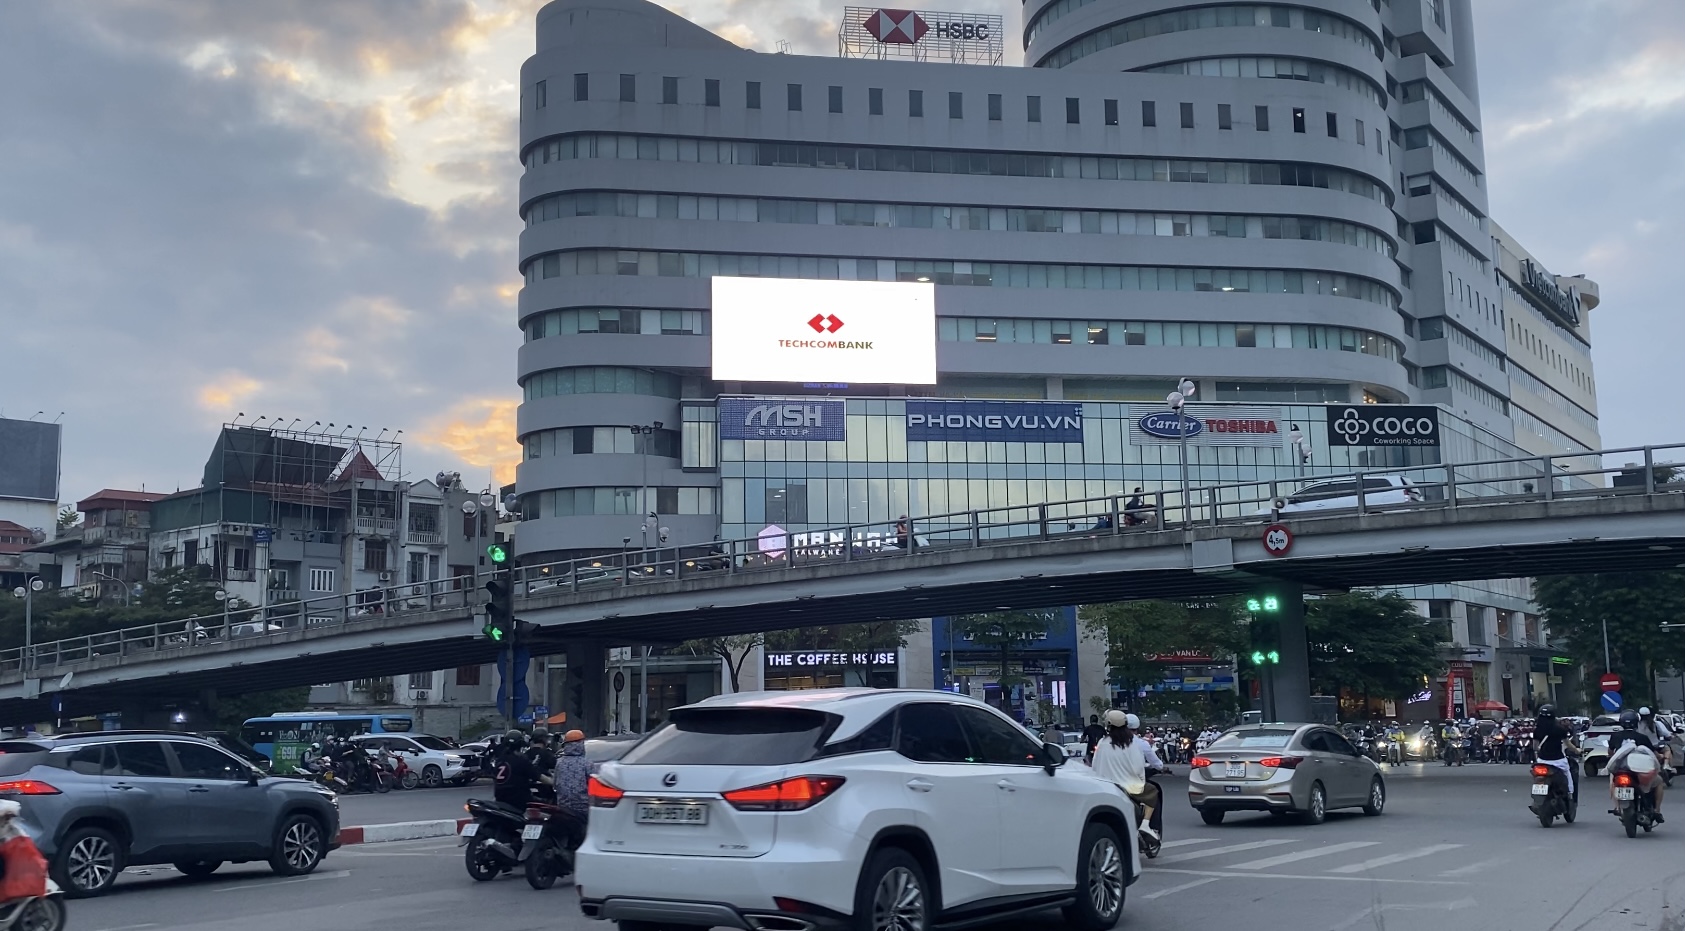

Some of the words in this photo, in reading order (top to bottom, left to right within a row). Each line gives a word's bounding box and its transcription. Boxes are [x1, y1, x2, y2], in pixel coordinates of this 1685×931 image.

[936, 22, 989, 40] HSBC
[778, 340, 873, 349] TECHCOMBANK
[744, 404, 822, 427] MSH
[908, 414, 1081, 429] PHONGVU.VN
[758, 428, 809, 436] GROUP
[1205, 419, 1278, 433] TOSHIBA
[1372, 417, 1433, 435] COGO
[1373, 437, 1412, 445] Coworking
[1413, 437, 1435, 445] Space
[768, 654, 793, 666] THE
[796, 653, 848, 666] COFFEE
[281, 746, 297, 760] 69K
[496, 765, 506, 779] Z
